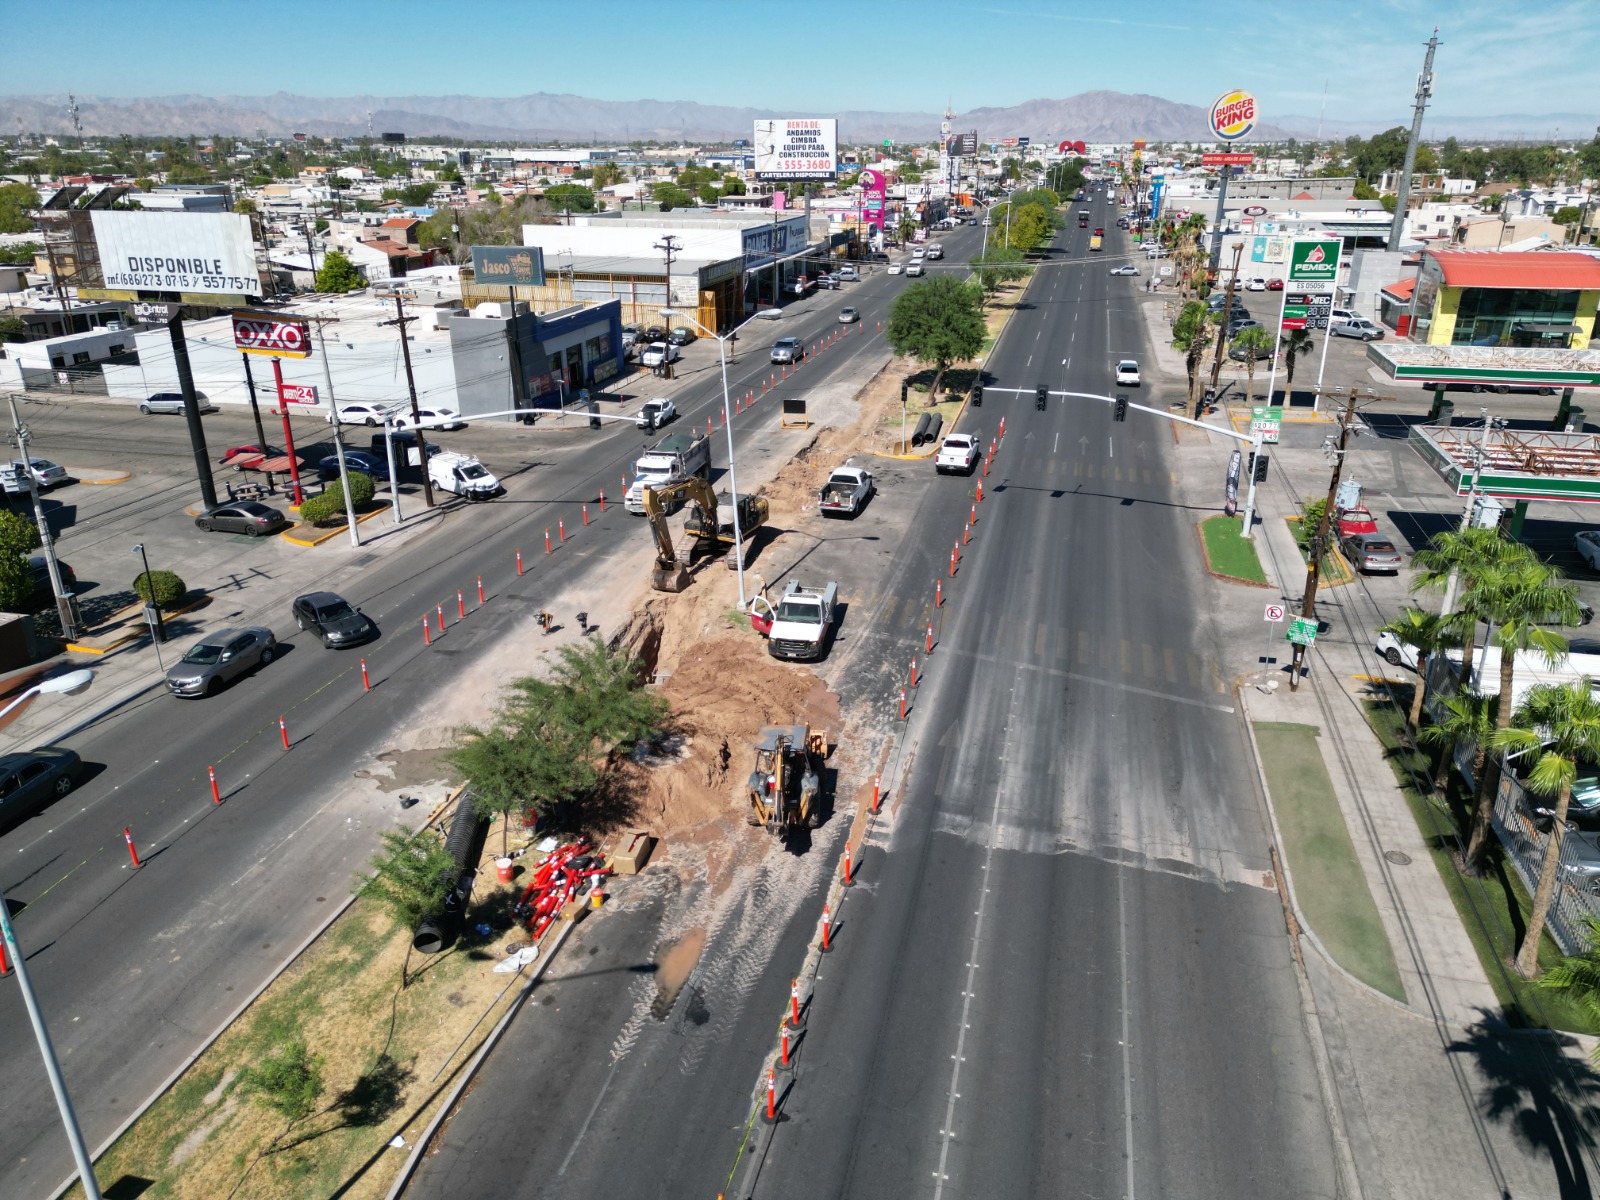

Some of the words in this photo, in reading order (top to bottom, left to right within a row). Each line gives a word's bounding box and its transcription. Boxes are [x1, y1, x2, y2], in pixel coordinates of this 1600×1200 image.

[1216, 98, 1253, 118] BURGER
[1216, 107, 1253, 130] KING
[785, 160, 831, 169] 555-3680
[128, 257, 222, 274] DISPONIBLE
[482, 258, 510, 274] Jasco
[236, 322, 301, 349] OXXO
[298, 387, 313, 399] 24
